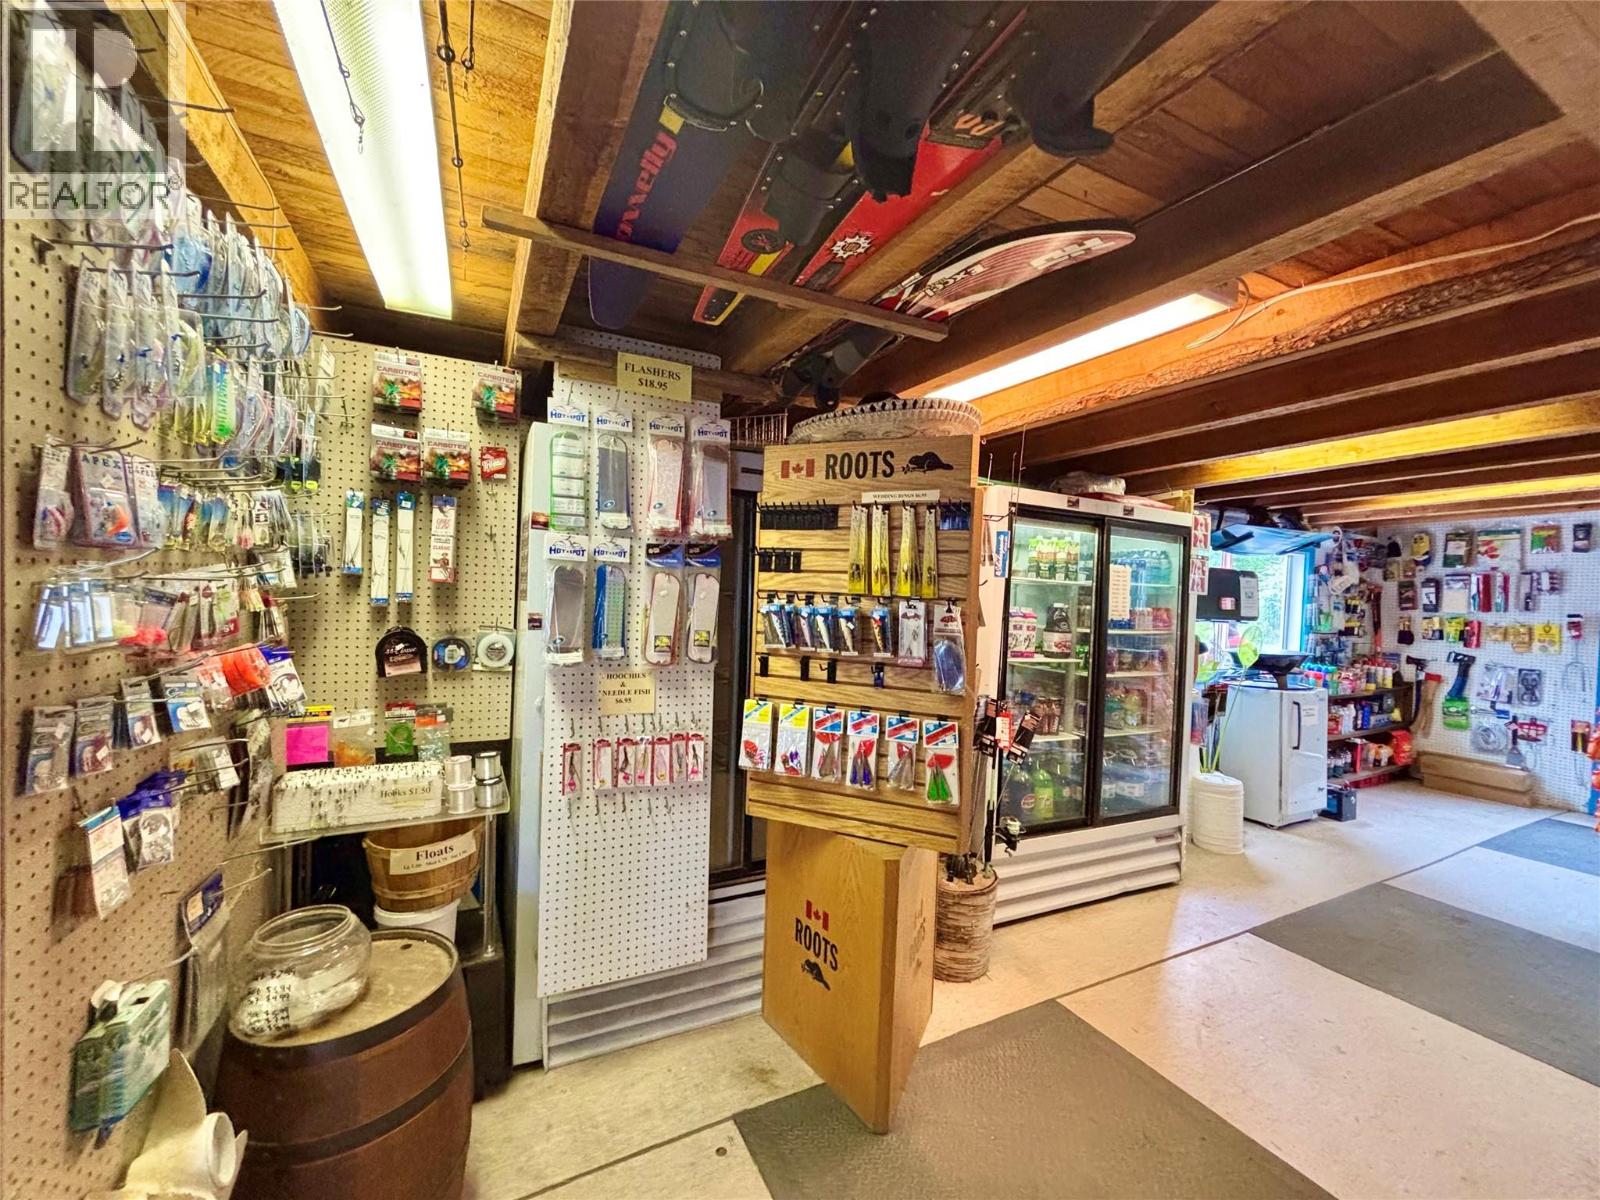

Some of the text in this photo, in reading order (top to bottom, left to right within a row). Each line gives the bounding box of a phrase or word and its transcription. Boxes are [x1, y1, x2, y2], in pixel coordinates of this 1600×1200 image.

[624, 362, 681, 381] FLASHERS
[638, 377, 668, 391] $18.95
[825, 450, 895, 480] ROOTS
[602, 689, 632, 697] NEEDLE
[408, 785, 431, 795] $1.50
[416, 845, 454, 862] Floats
[795, 917, 838, 972] ROOTS
